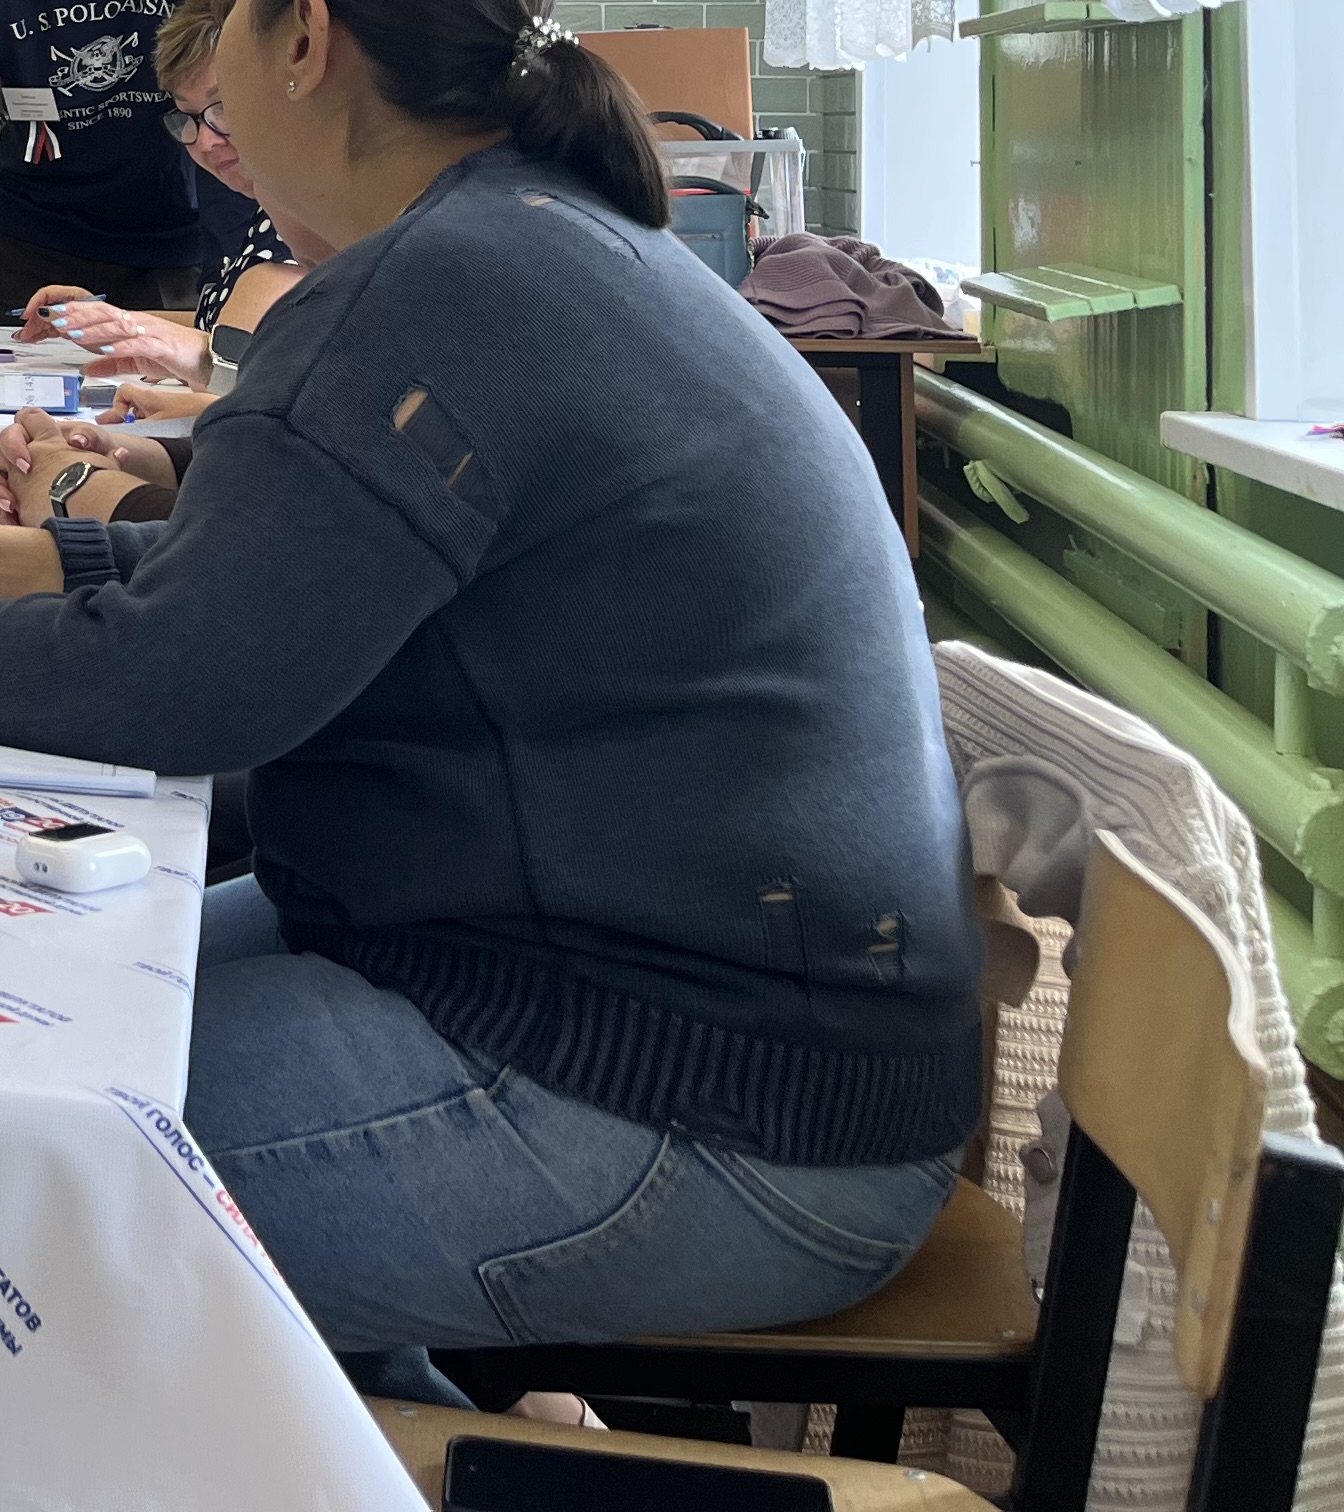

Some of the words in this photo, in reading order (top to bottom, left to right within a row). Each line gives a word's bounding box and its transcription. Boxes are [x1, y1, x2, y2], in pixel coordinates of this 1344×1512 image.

[10, 19, 34, 40] U.
[53, 1, 121, 27] POLO
[98, 91, 172, 111] SPORTSWEA
[67, 113, 104, 130] SINCE
[107, 107, 132, 119] 1890
[146, 1109, 205, 1172] ГОЛОС
